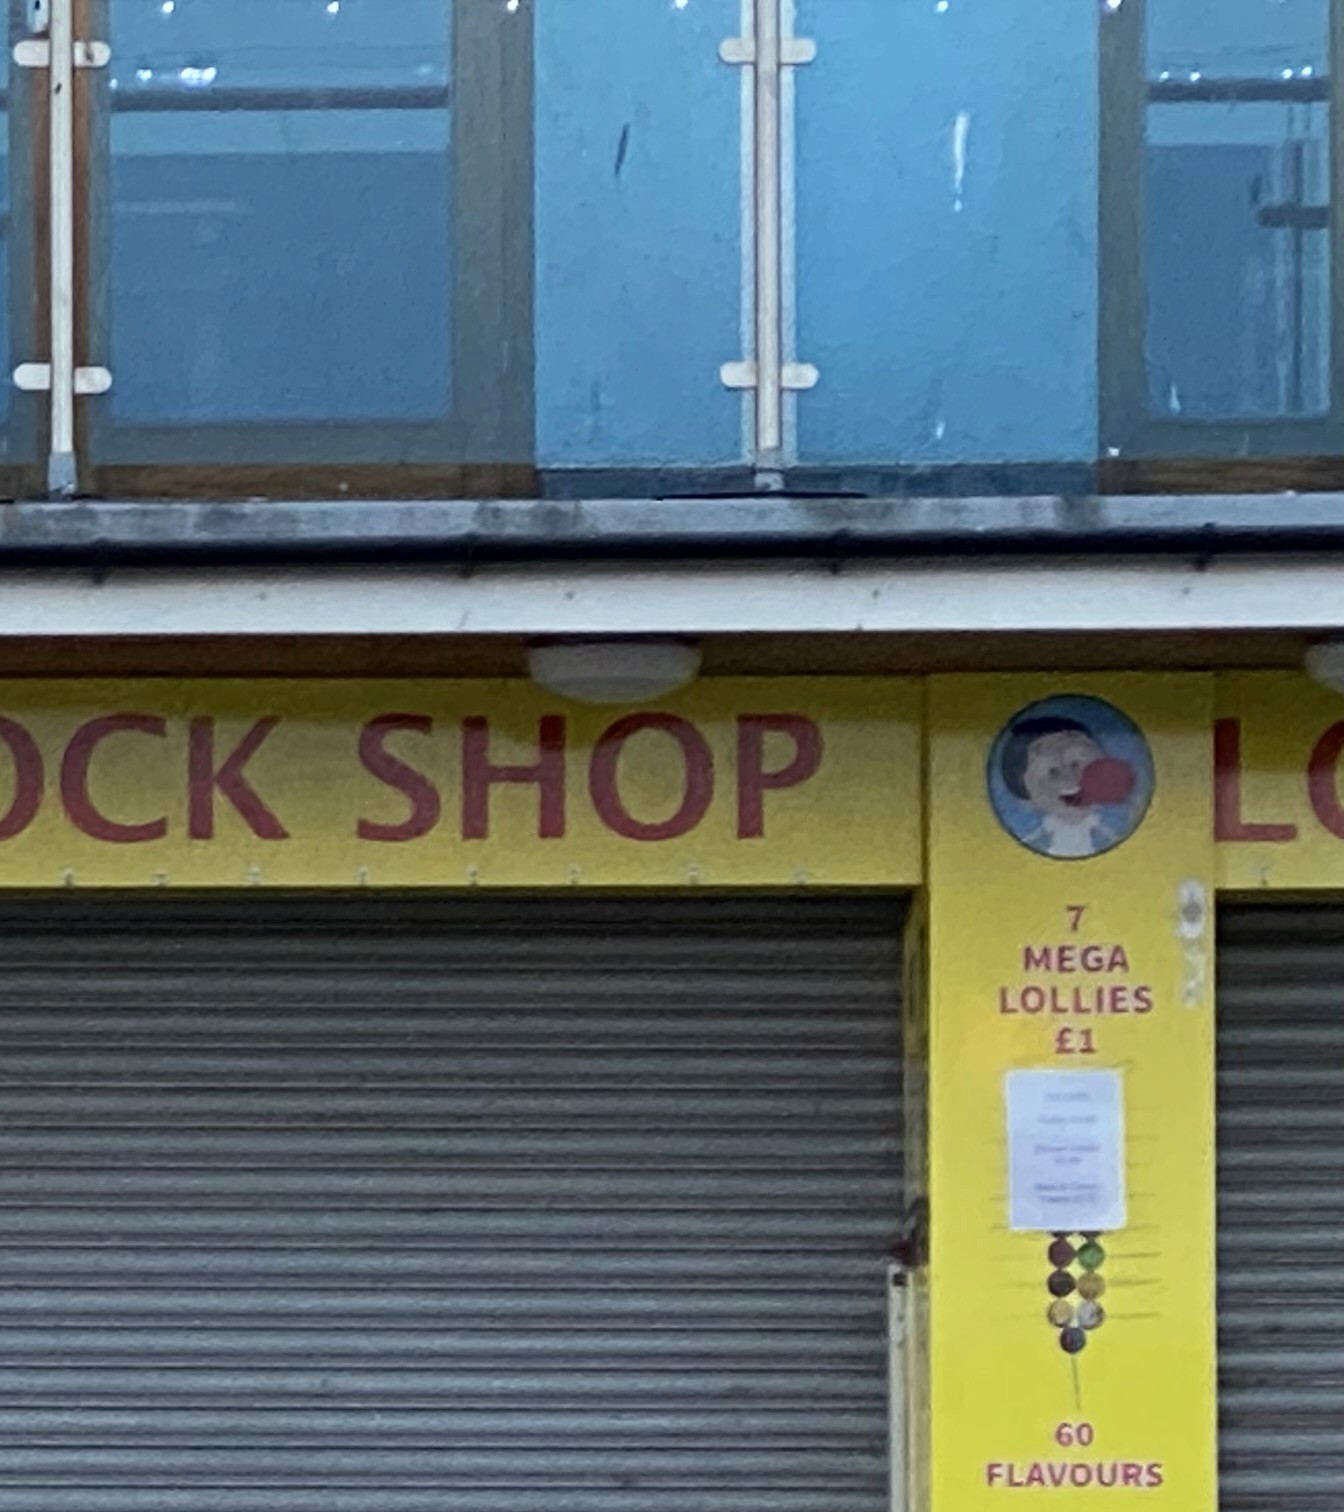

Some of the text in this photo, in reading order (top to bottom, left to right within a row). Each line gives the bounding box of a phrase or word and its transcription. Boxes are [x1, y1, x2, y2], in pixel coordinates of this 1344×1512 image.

[356, 711, 824, 843] SHOP
[1067, 905, 1087, 932] 7
[1023, 946, 1129, 973] MEGA
[999, 986, 1153, 1014] LOLLIES
[1054, 1027, 1097, 1054] £1
[1055, 1423, 1094, 1447] 60
[986, 1463, 1164, 1488] FLAVOURS
